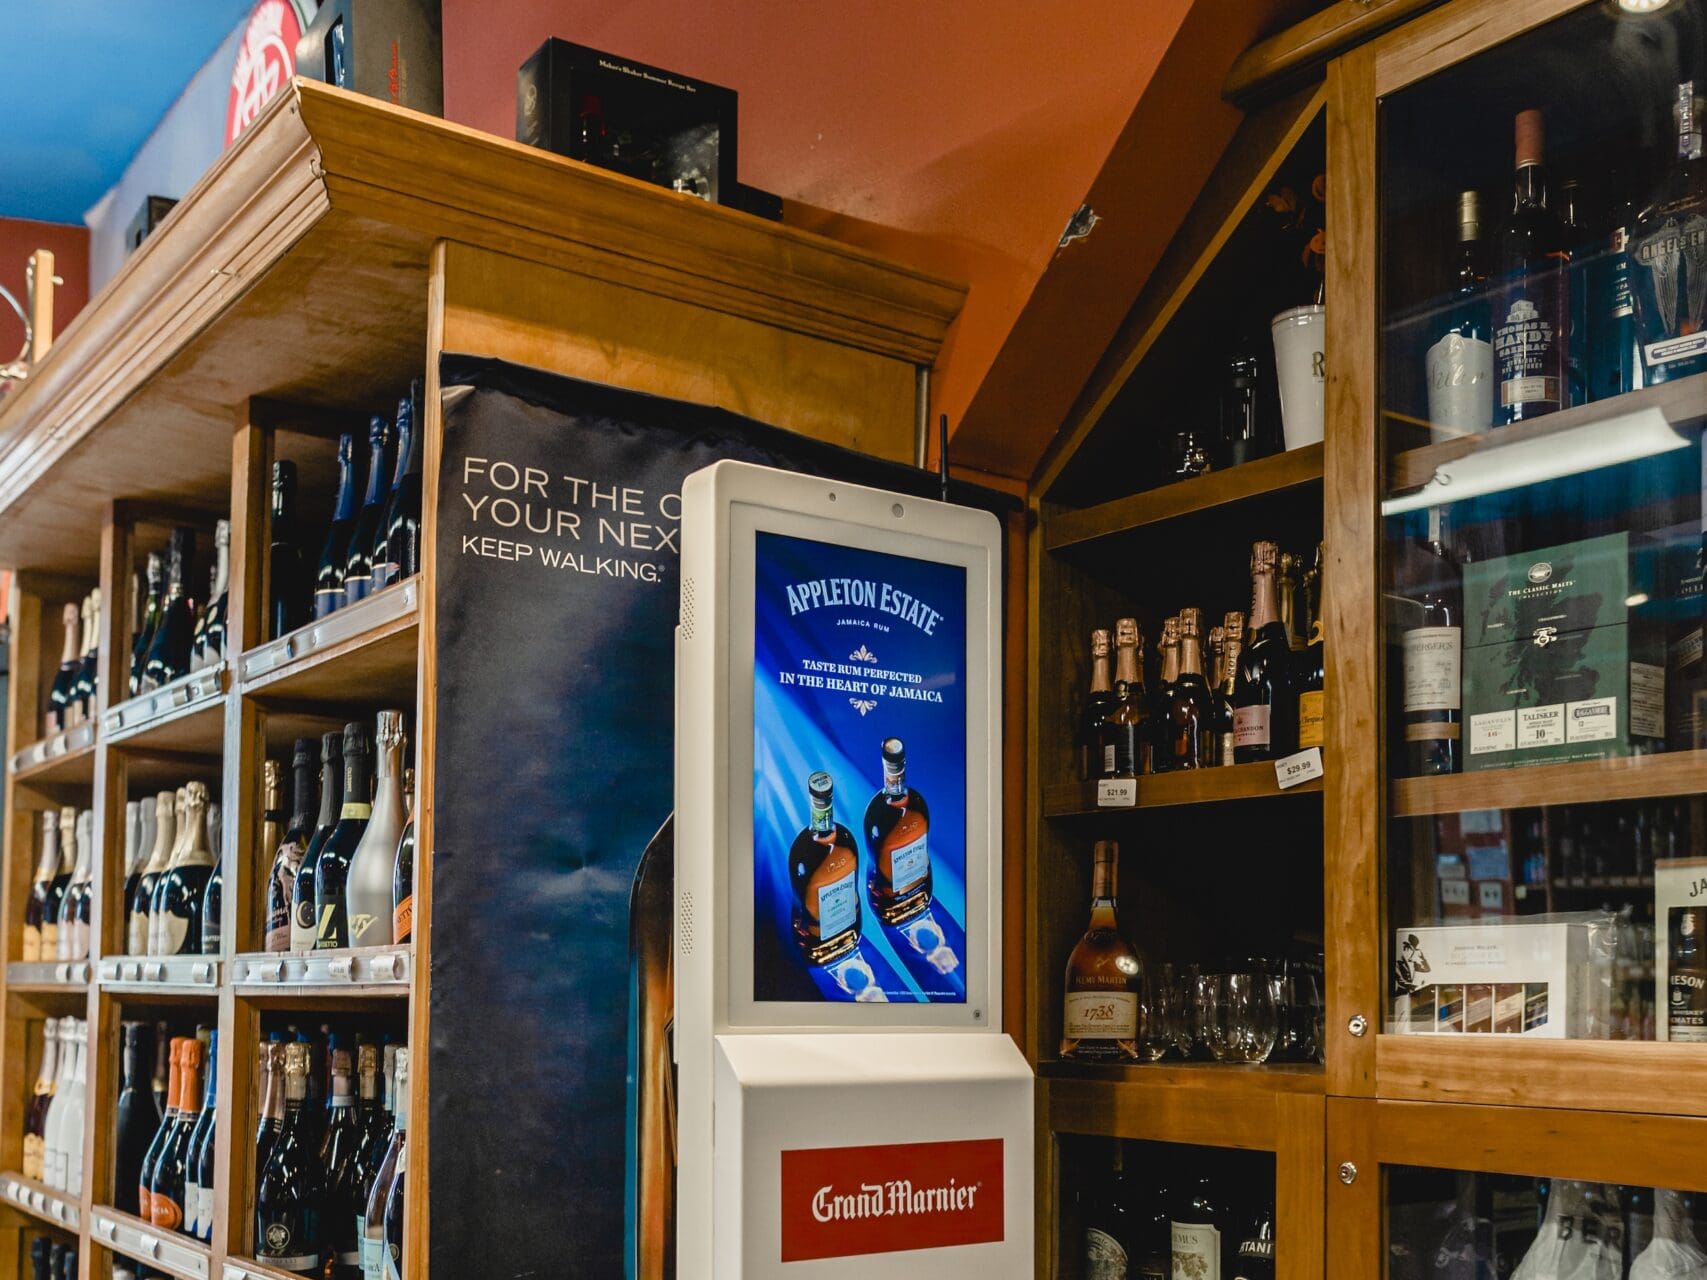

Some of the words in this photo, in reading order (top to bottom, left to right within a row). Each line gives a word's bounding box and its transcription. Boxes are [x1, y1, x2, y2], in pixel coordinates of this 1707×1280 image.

[1495, 330, 1553, 351] HANDY
[463, 456, 549, 498] FOR
[563, 476, 645, 516] THE
[462, 492, 582, 541] YOUR
[462, 535, 533, 562] KEEP
[1523, 584, 1550, 594] CLASSIC
[785, 578, 876, 616] APPLETON
[879, 583, 940, 636] ESTATE
[836, 618, 870, 628] JAMAICA
[873, 623, 890, 633] RUM
[802, 659, 836, 674] TASTE
[838, 664, 862, 677] RUM
[863, 668, 922, 684] PERFECTED
[779, 671, 795, 685] IN
[796, 674, 824, 688] THE
[826, 678, 868, 694] HEART
[870, 683, 887, 696] OF
[889, 686, 943, 703] JAMAICA
[1521, 710, 1559, 721] TALISKER
[1535, 729, 1546, 739] 10
[1286, 761, 1311, 775] $29.99
[1106, 788, 1128, 796] $21.99
[1084, 1004, 1115, 1021] 1738
[811, 1182, 883, 1223] Grand
[883, 1177, 978, 1216] Marnier
